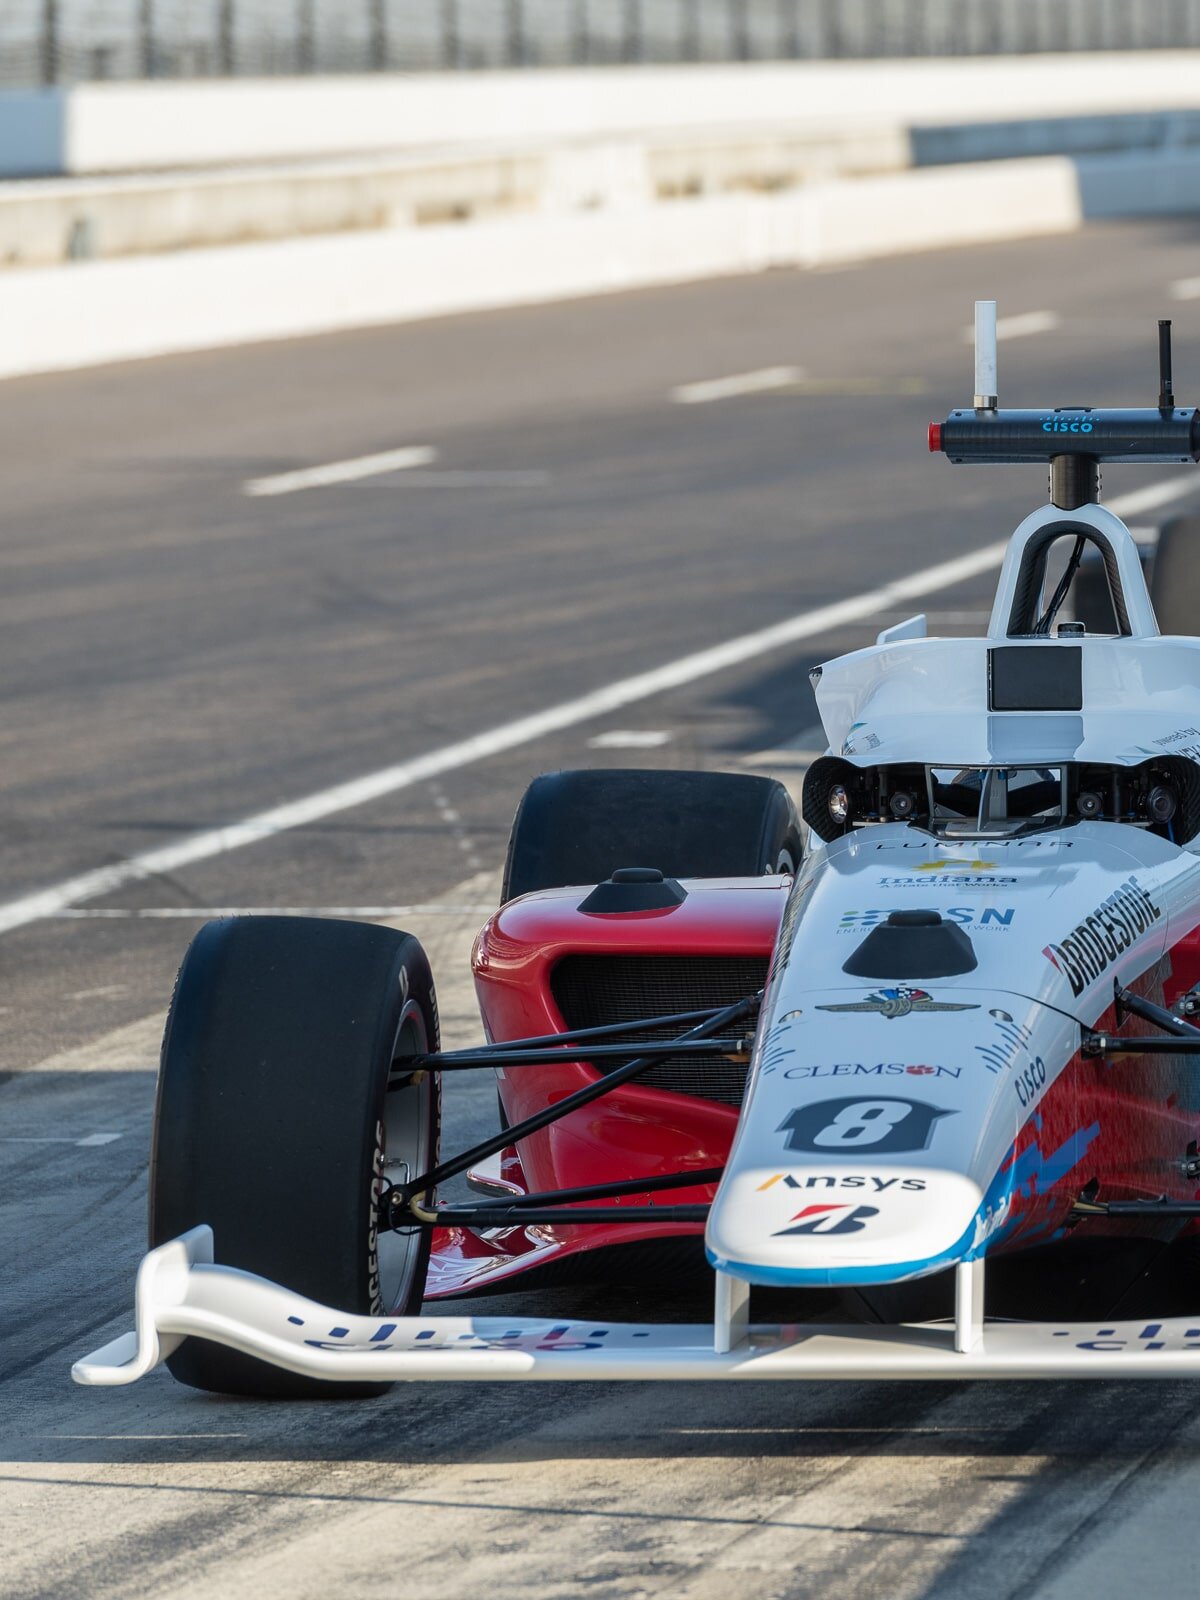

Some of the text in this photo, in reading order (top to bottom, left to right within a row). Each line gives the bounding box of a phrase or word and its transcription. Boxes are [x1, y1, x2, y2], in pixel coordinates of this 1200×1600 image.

[876, 840, 1074, 850] LUMINAR
[876, 875, 1018, 884] Indiana
[917, 907, 1015, 925] SN
[1043, 875, 1162, 998] BRIDGESTONE
[813, 1100, 914, 1147] 8
[756, 1174, 927, 1192] Ansys
[368, 1119, 385, 1316] DGESTONE
